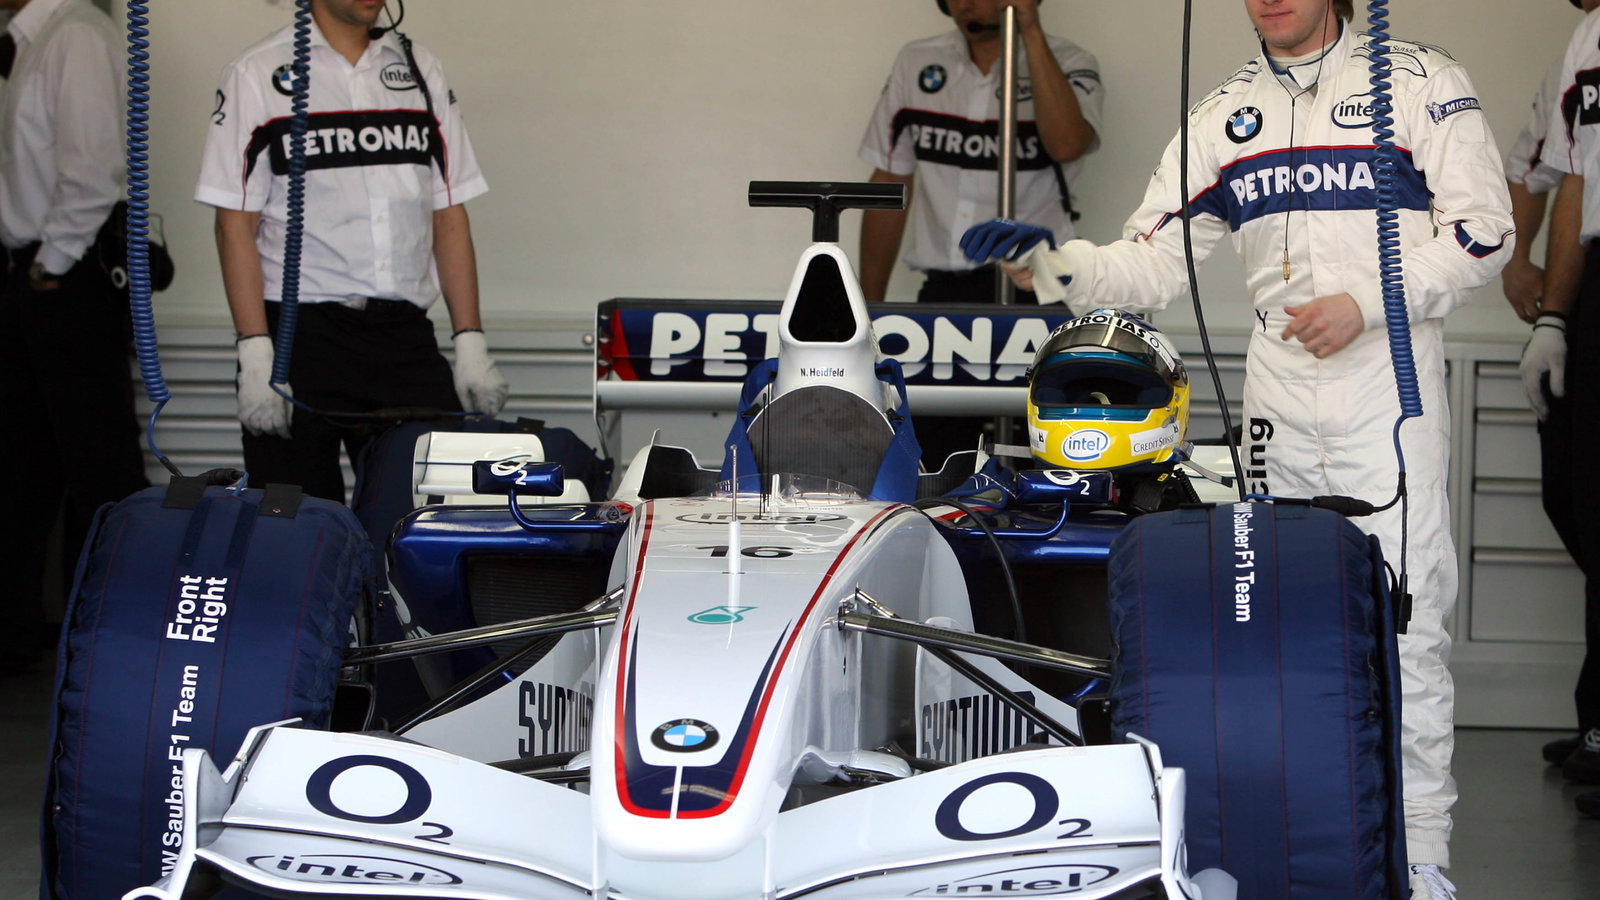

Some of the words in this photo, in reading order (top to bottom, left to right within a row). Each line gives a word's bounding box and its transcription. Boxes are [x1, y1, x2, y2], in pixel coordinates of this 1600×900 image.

[384, 69, 415, 83] inte
[1338, 101, 1378, 117] inte
[1582, 84, 1600, 110] P
[1229, 162, 1382, 207] PETRONA
[649, 311, 1052, 381] PETONA
[809, 367, 845, 377] Heidfeld
[491, 458, 528, 486] O2
[1043, 469, 1090, 496] O2
[1233, 513, 1254, 549] Sauber
[696, 545, 793, 558] 16
[1235, 550, 1255, 569] F1
[166, 575, 202, 641] Front
[192, 576, 228, 643] Right
[1235, 571, 1255, 622] Team
[171, 664, 199, 727] Team
[168, 734, 191, 761] F1
[162, 765, 184, 848] Sauber
[306, 754, 454, 845] O2
[935, 771, 1094, 840] O2
[162, 849, 180, 877] W
[276, 855, 426, 883] intel
[936, 873, 1081, 894] intel
